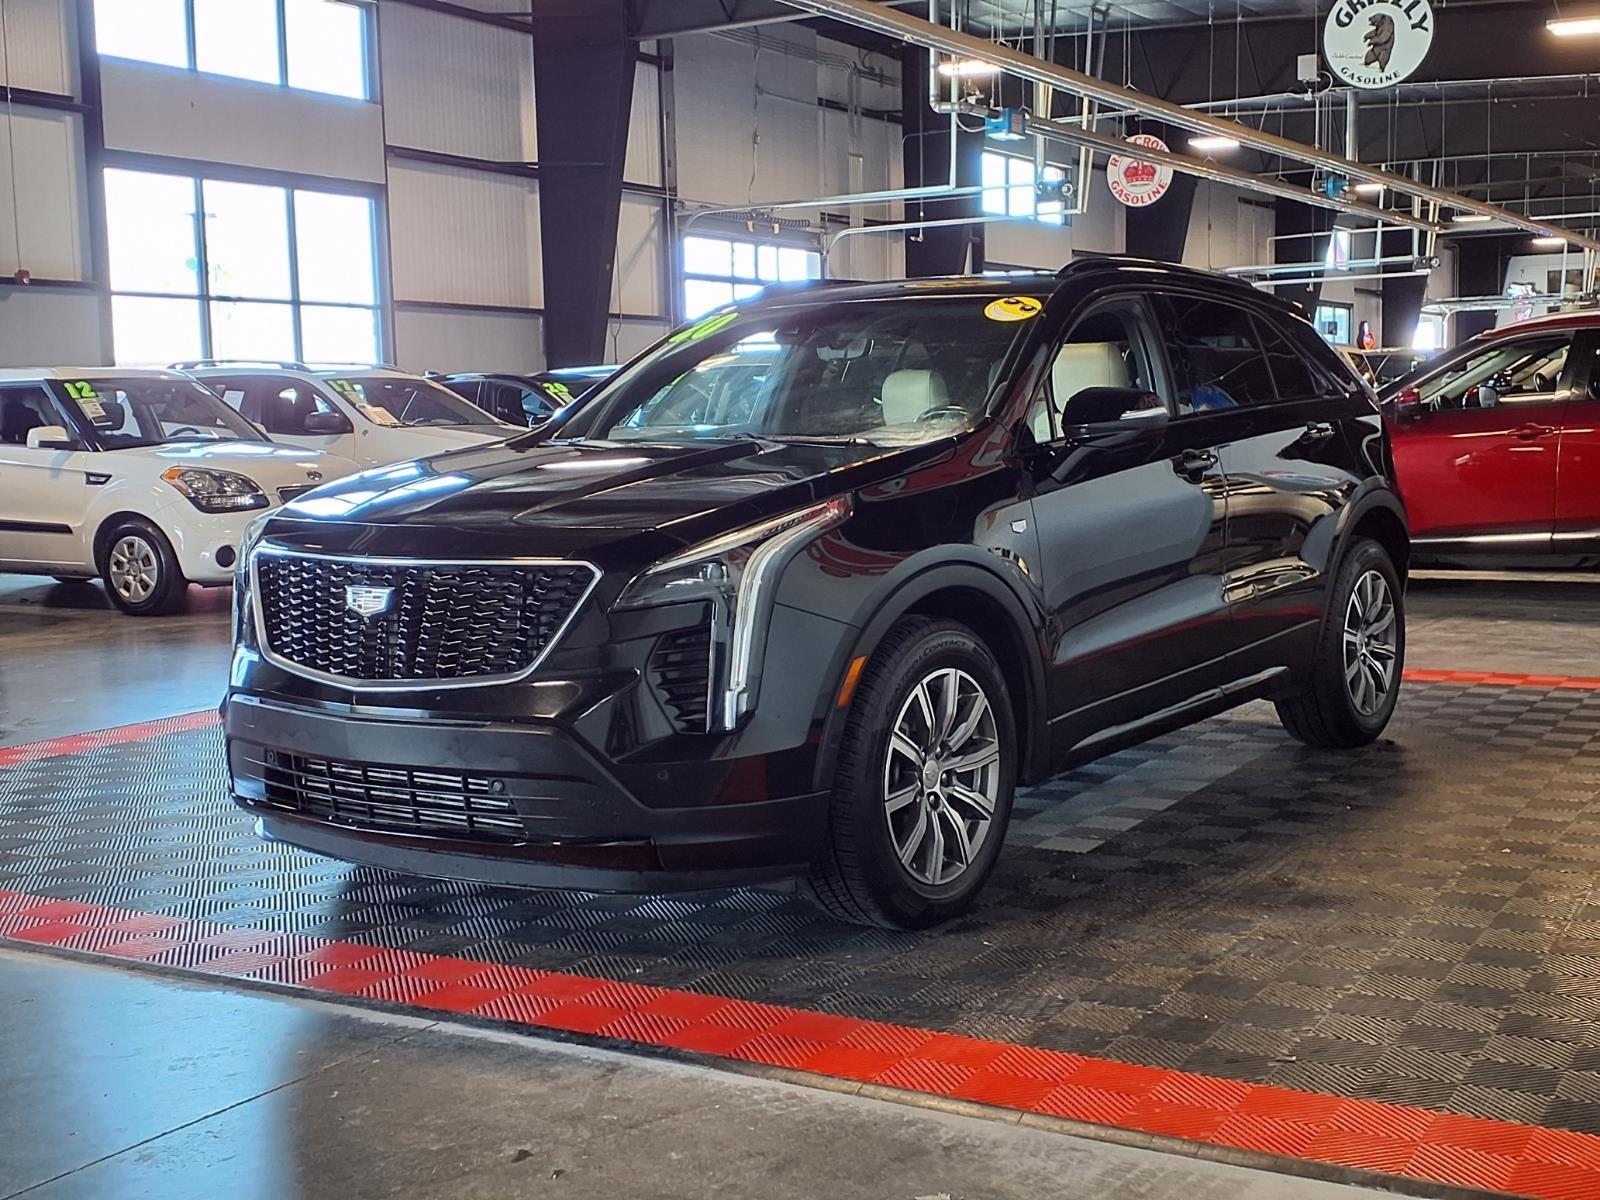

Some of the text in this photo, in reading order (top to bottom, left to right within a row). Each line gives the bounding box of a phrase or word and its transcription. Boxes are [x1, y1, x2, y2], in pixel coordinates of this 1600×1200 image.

[1336, 0, 1428, 32] GRLY
[1340, 66, 1401, 84] GASOLINE
[1134, 136, 1166, 151] CRO
[1111, 180, 1168, 205] GASOLINE
[63, 381, 97, 399] 12
